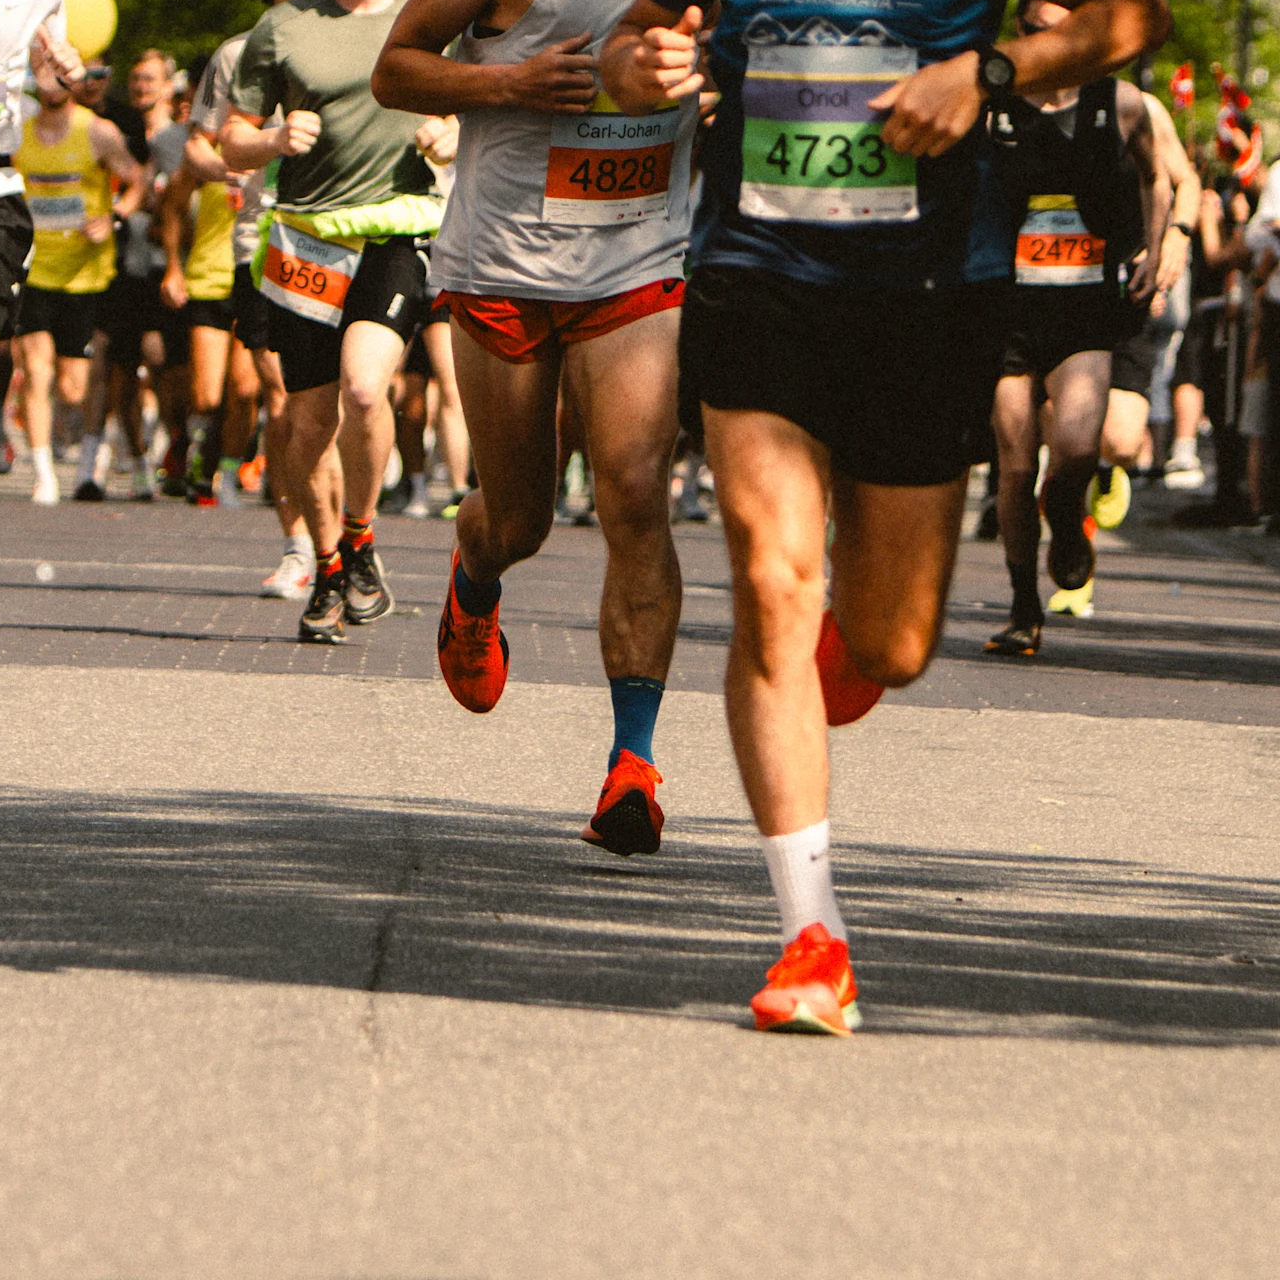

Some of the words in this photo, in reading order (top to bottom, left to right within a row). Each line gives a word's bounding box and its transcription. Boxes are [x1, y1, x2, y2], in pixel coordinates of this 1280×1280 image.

[576, 122, 661, 139] Carl-Johan
[765, 131, 887, 178] 4733
[568, 154, 657, 193] 4828
[295, 236, 330, 259] Danni
[1030, 237, 1094, 262] 2479
[280, 260, 327, 295] 959
